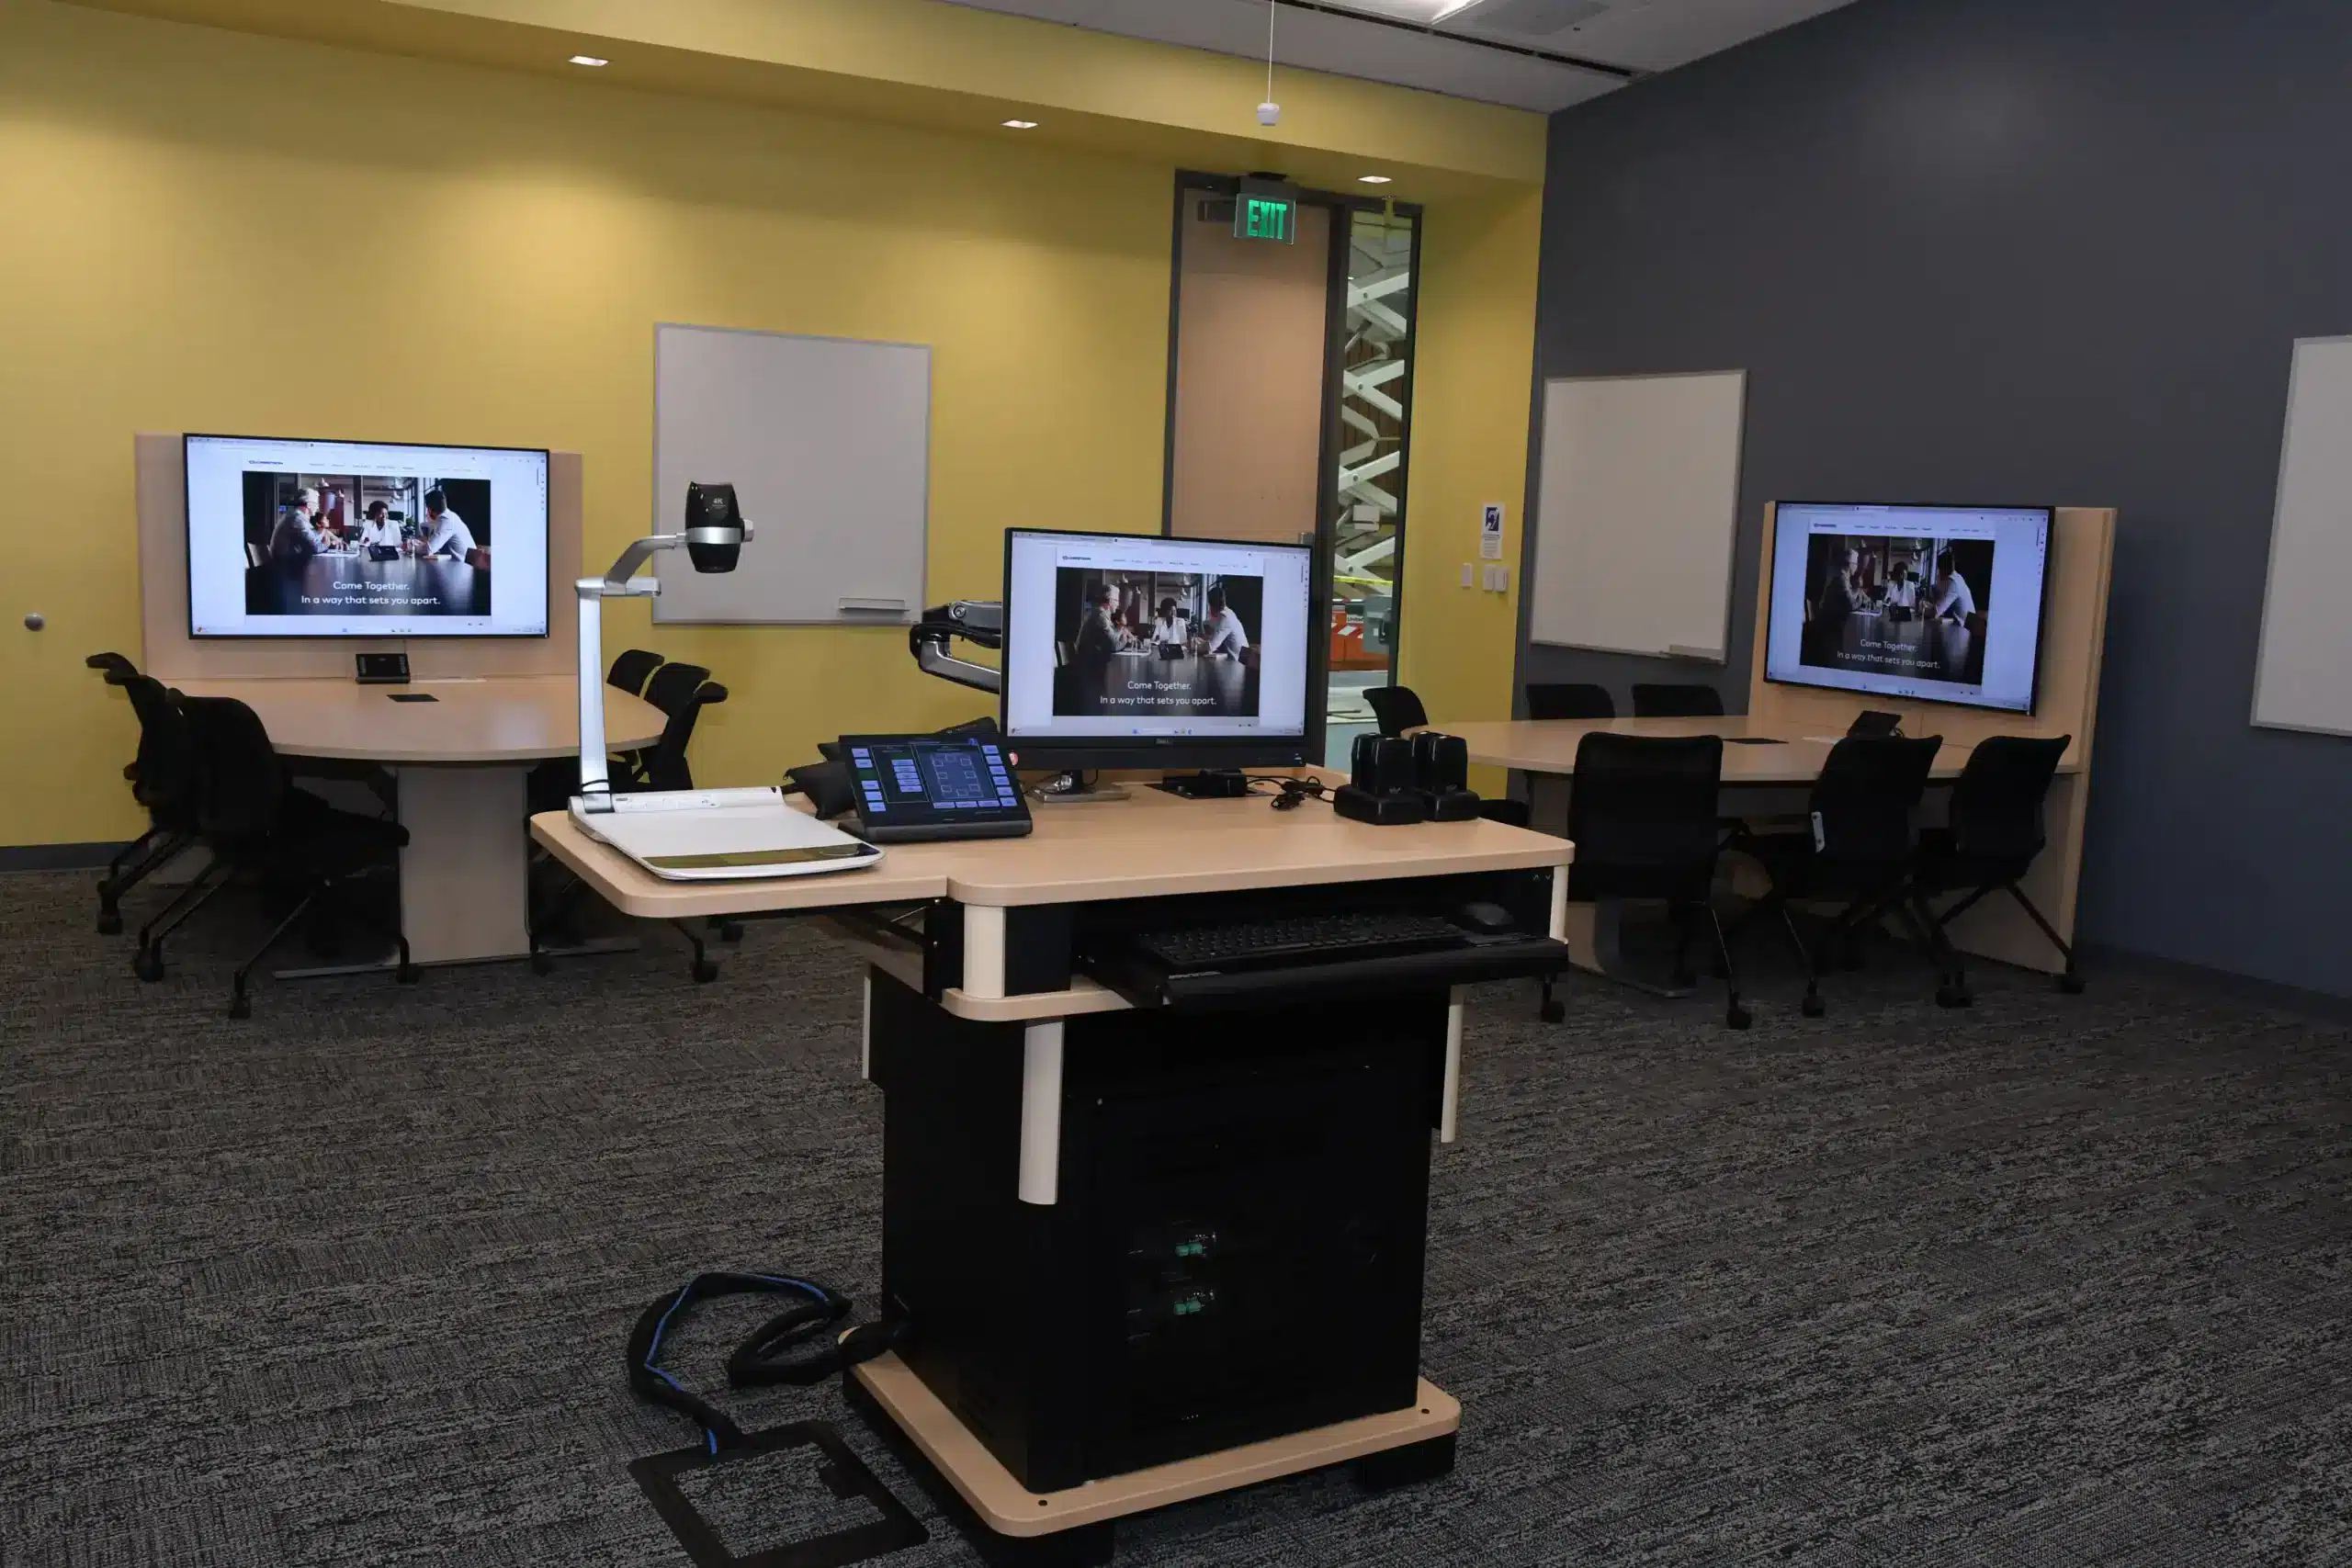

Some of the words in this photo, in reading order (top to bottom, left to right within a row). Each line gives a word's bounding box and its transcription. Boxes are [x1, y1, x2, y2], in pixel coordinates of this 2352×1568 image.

[1248, 199, 1286, 239] EXIT
[333, 581, 362, 590] Come
[365, 581, 410, 592] Together.
[301, 595, 311, 604] In
[322, 597, 343, 605] way
[345, 596, 366, 604] that
[391, 597, 408, 606] you
[411, 597, 440, 606] apart.
[1860, 638, 1882, 649] Come
[1838, 650, 1844, 659] In
[1851, 653, 1866, 661] way
[1868, 654, 1883, 662] that
[1885, 656, 1900, 665] sets
[1902, 659, 1915, 667] you
[1917, 660, 1940, 669] apart.
[1127, 681, 1151, 689] Come
[1154, 681, 1191, 691] Together.
[1100, 695, 1107, 704] In
[1117, 697, 1135, 705] way
[1176, 697, 1190, 705] you
[1192, 697, 1217, 705] apart.
